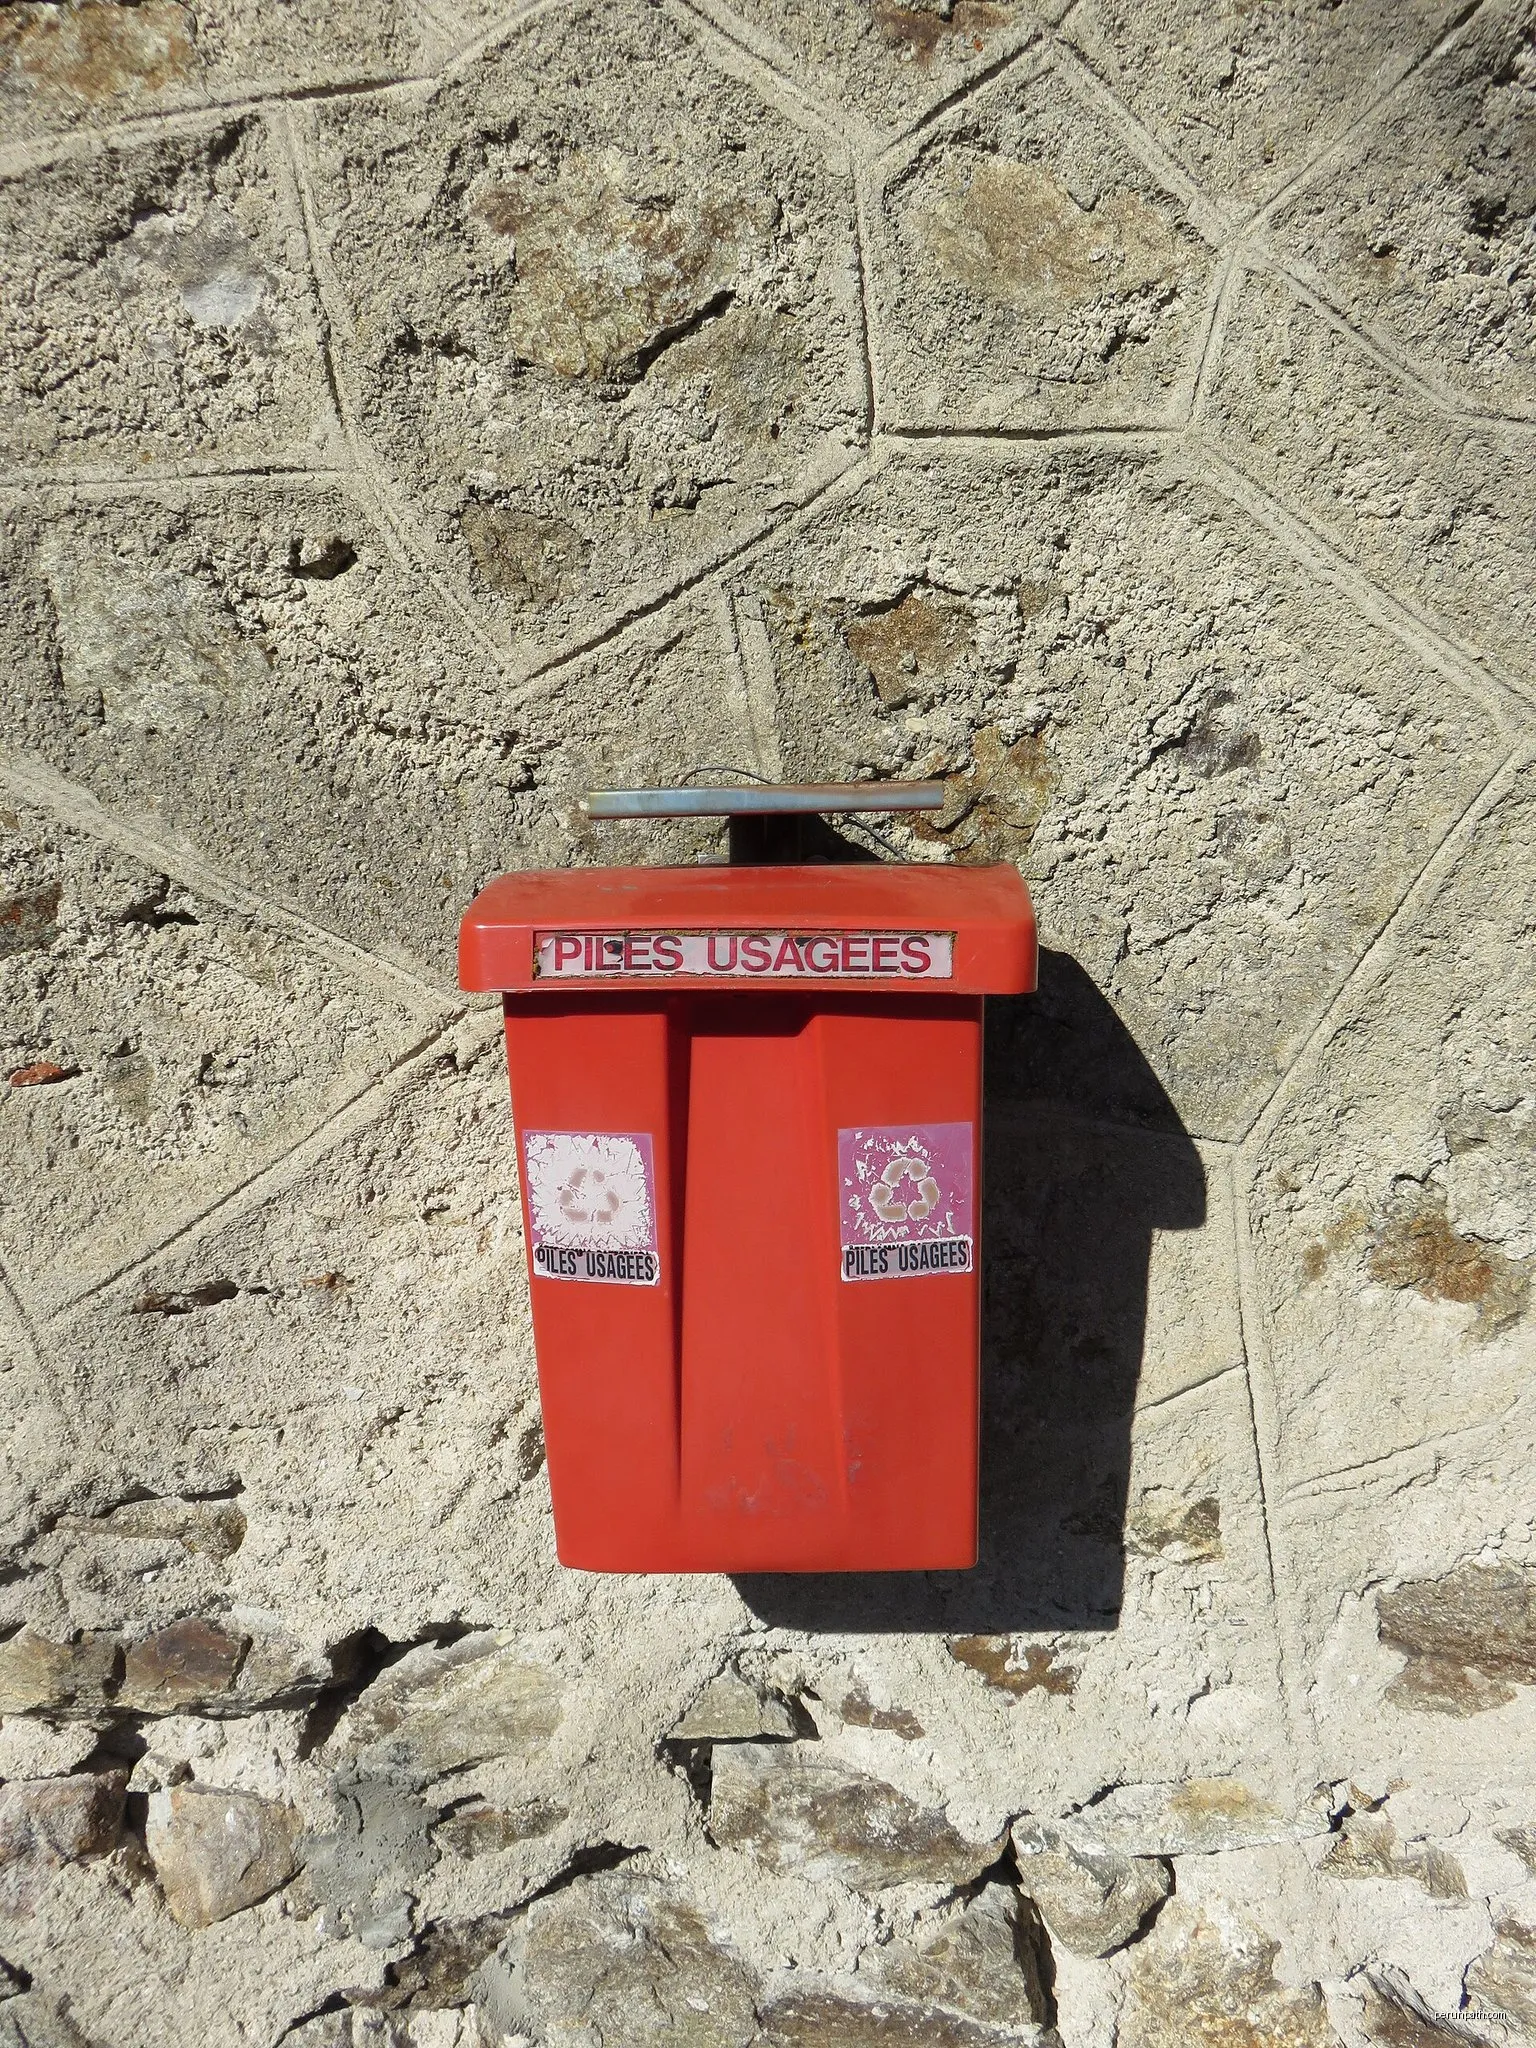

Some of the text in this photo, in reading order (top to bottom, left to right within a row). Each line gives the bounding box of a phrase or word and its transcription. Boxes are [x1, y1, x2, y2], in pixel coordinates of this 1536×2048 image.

[554, 935, 932, 974] PILES USAGEES
[535, 1247, 577, 1275] PILES
[586, 1252, 654, 1281] USAGEES
[845, 1240, 968, 1277] PILES USAGEES
